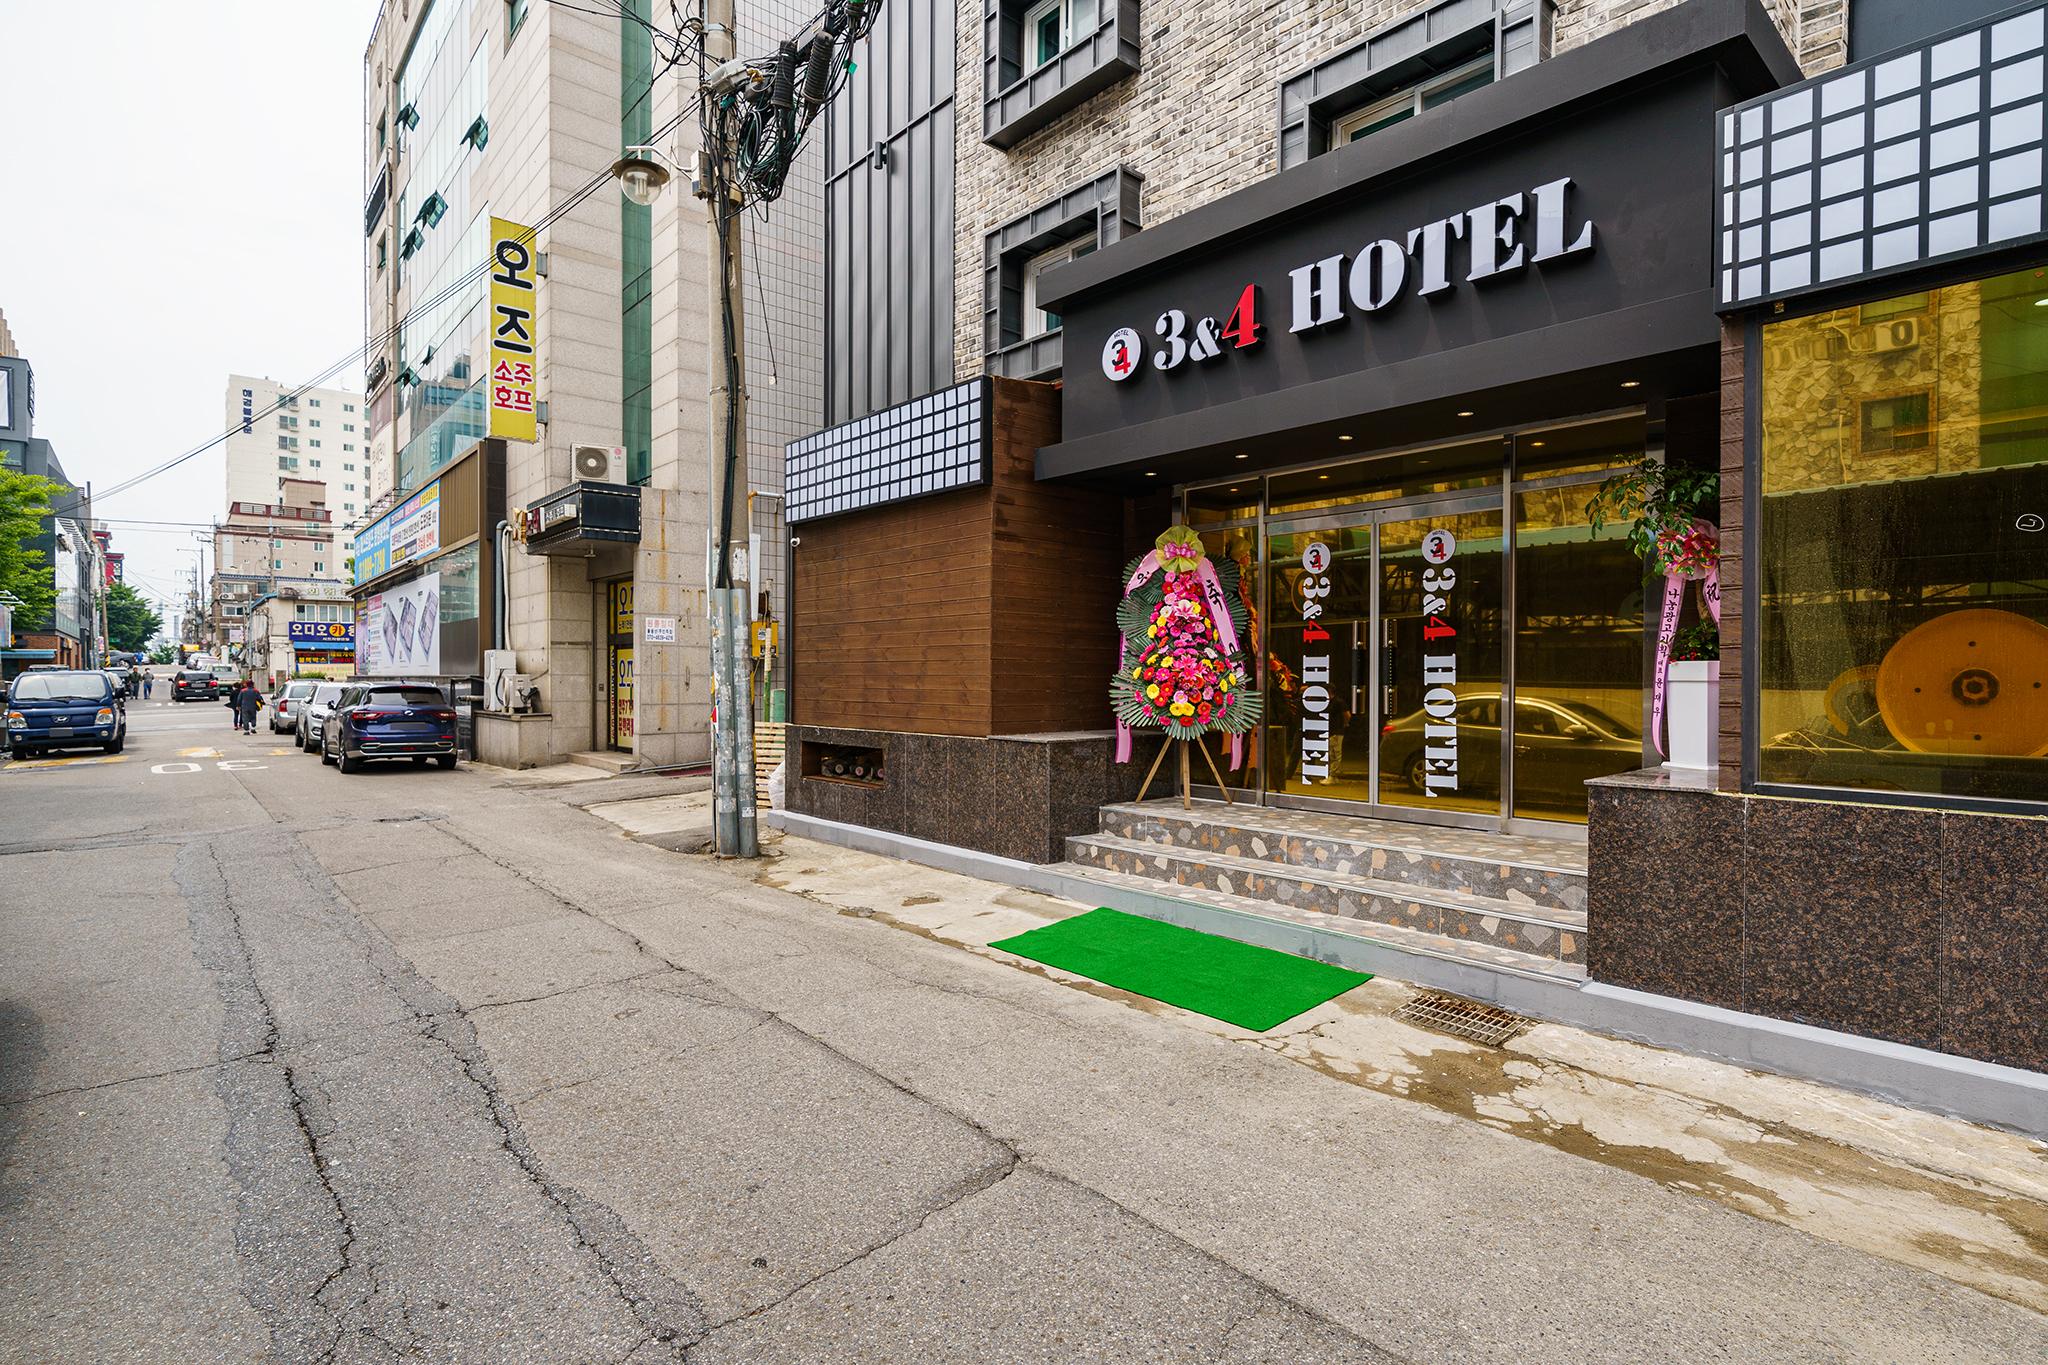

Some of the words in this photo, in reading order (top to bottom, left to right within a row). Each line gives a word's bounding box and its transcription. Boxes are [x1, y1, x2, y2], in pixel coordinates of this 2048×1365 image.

[493, 240, 533, 354] 오즈
[1153, 283, 1266, 370] 3&4
[1289, 177, 1597, 335] HOTEL
[494, 360, 532, 386] 소주
[494, 385, 533, 412] 호프
[1303, 576, 1331, 644] 3&4
[1422, 567, 1457, 641] 3&4
[1302, 654, 1330, 785] HOTEL
[1423, 653, 1458, 798] HOTEL
